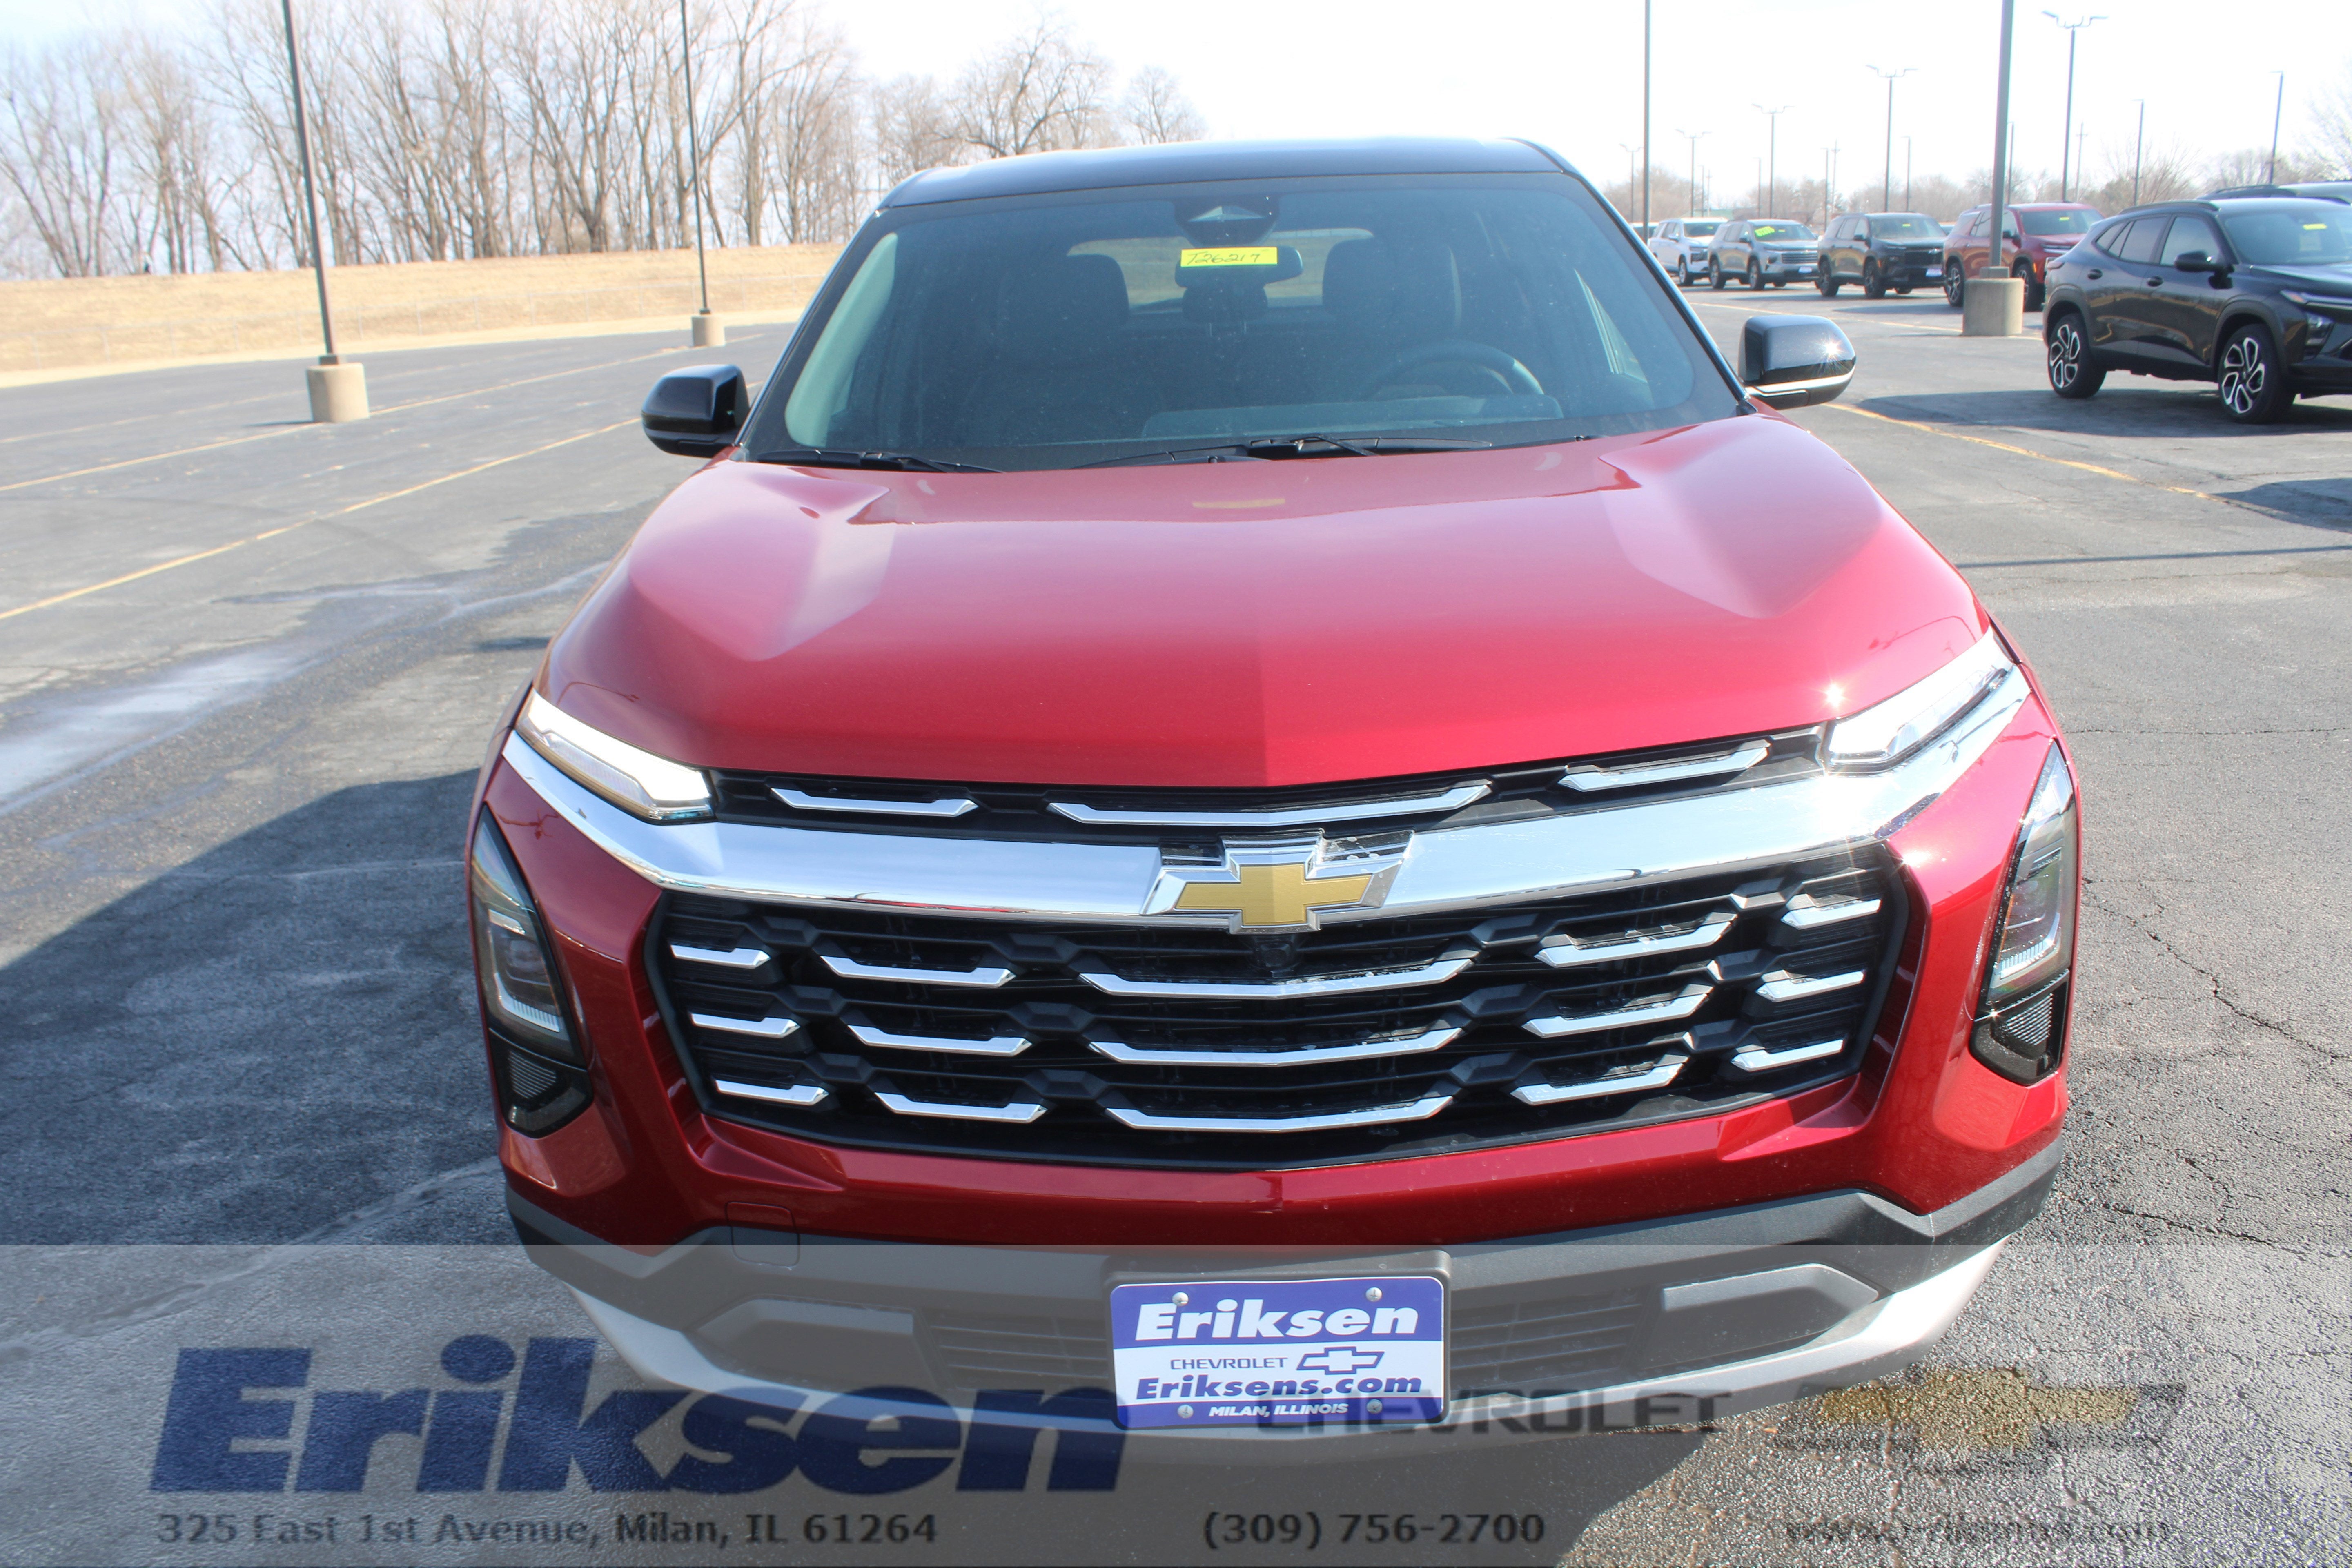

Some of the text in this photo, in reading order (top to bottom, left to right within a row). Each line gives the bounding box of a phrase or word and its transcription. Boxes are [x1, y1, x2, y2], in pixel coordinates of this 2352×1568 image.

[1135, 1298, 1419, 1341] Eriksen
[1170, 1357, 1288, 1370] CHEVROLET
[1136, 1374, 1422, 1400] Eriksens.com
[1209, 1403, 1349, 1418] MILAN, ILLINOIS
